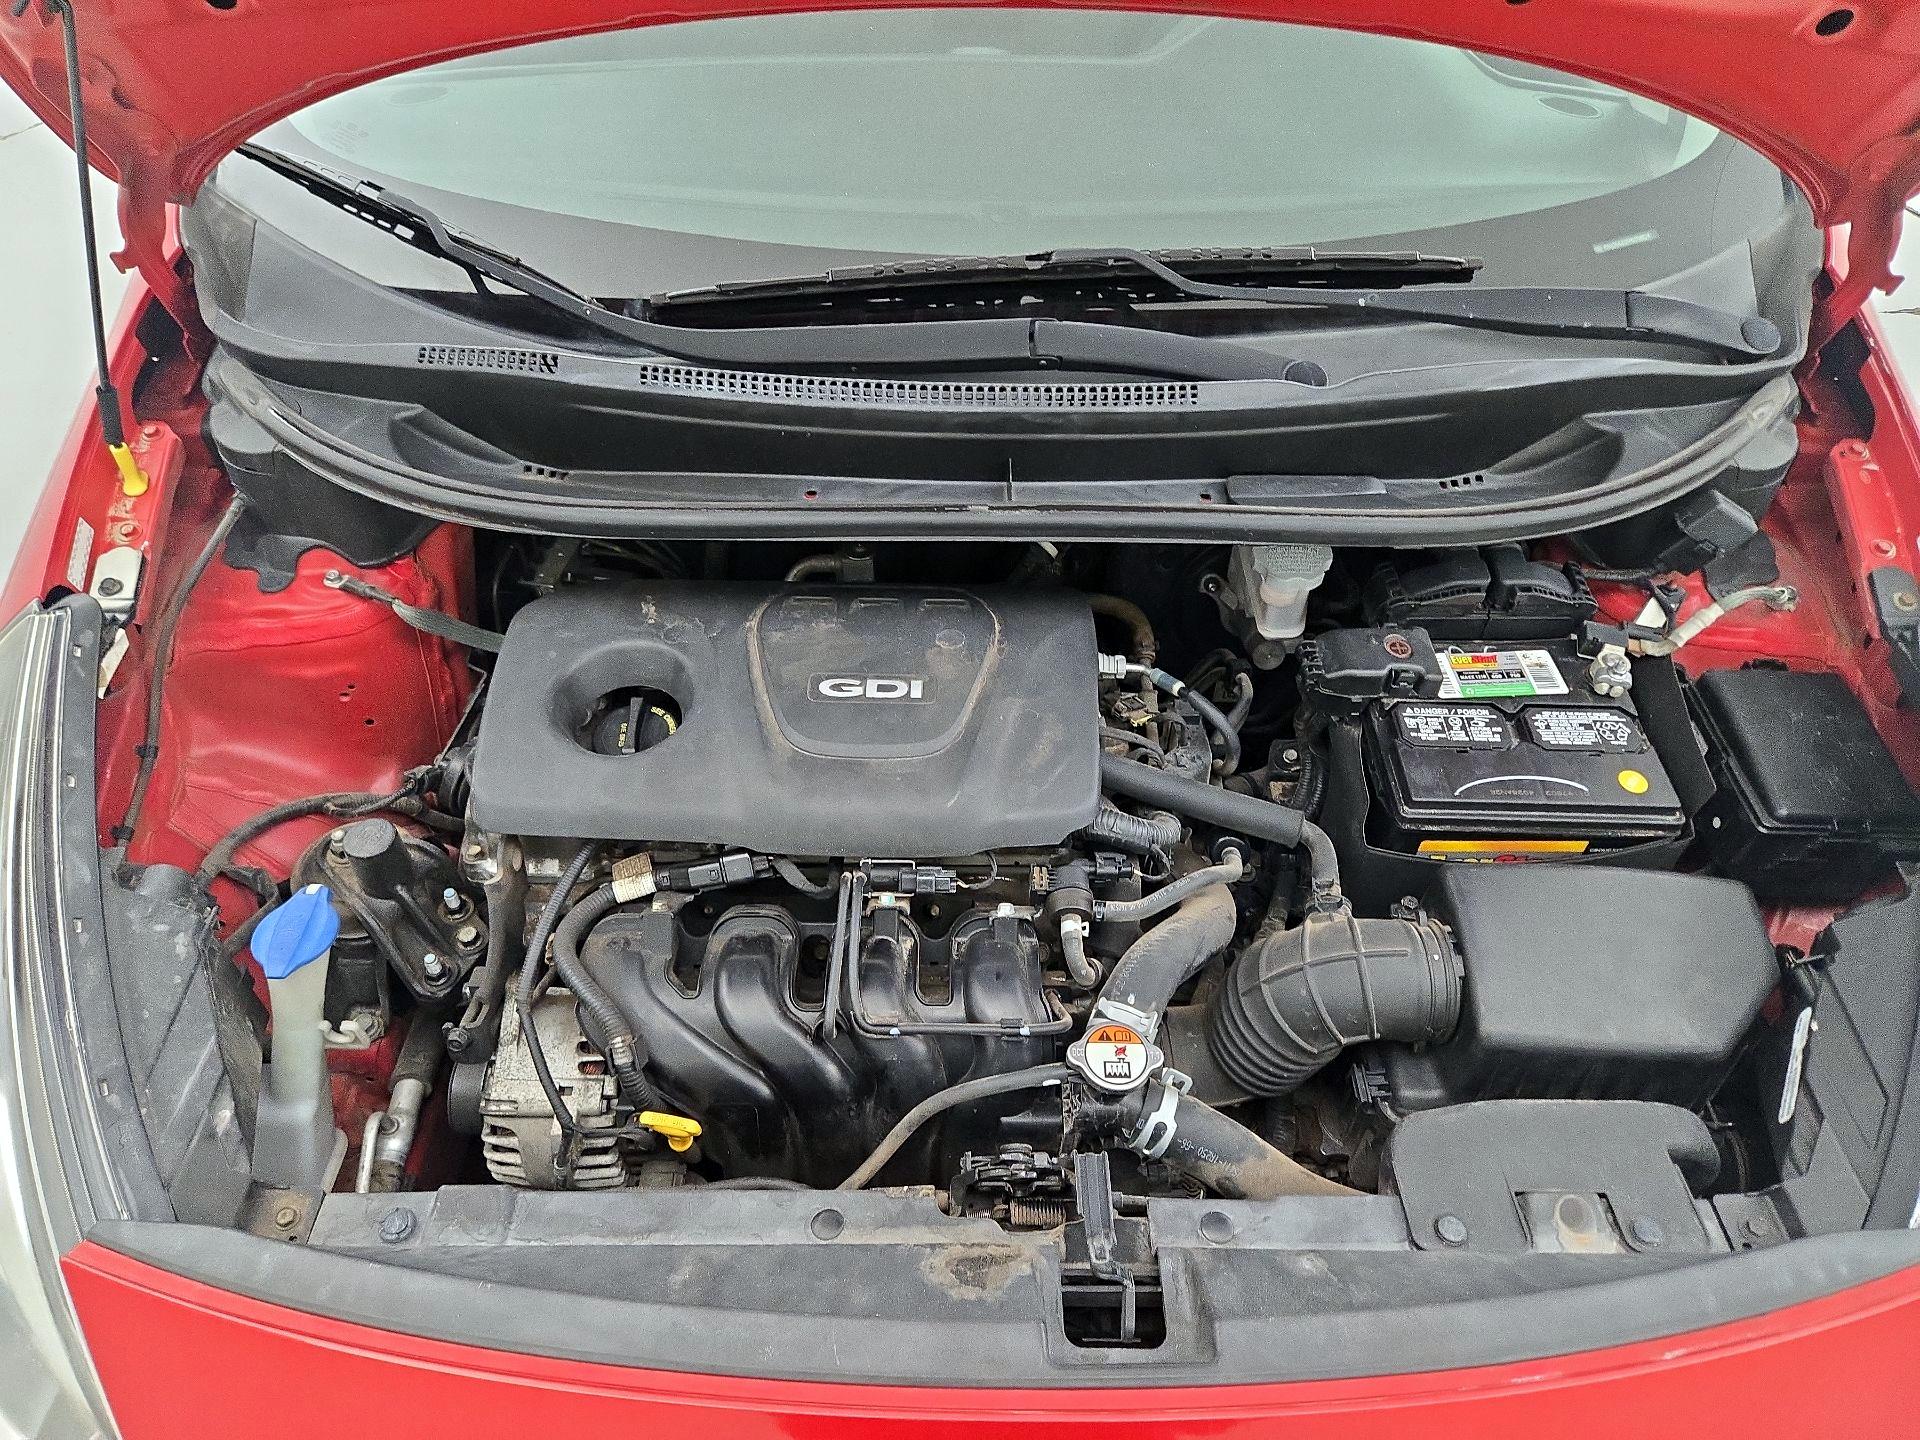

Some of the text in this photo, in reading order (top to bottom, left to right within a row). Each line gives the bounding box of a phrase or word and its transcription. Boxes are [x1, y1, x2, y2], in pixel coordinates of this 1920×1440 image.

[1451, 654, 1498, 665] EverStart
[818, 678, 924, 698] GDI
[1413, 707, 1449, 715] DANGER
[1456, 708, 1490, 716] POISON
